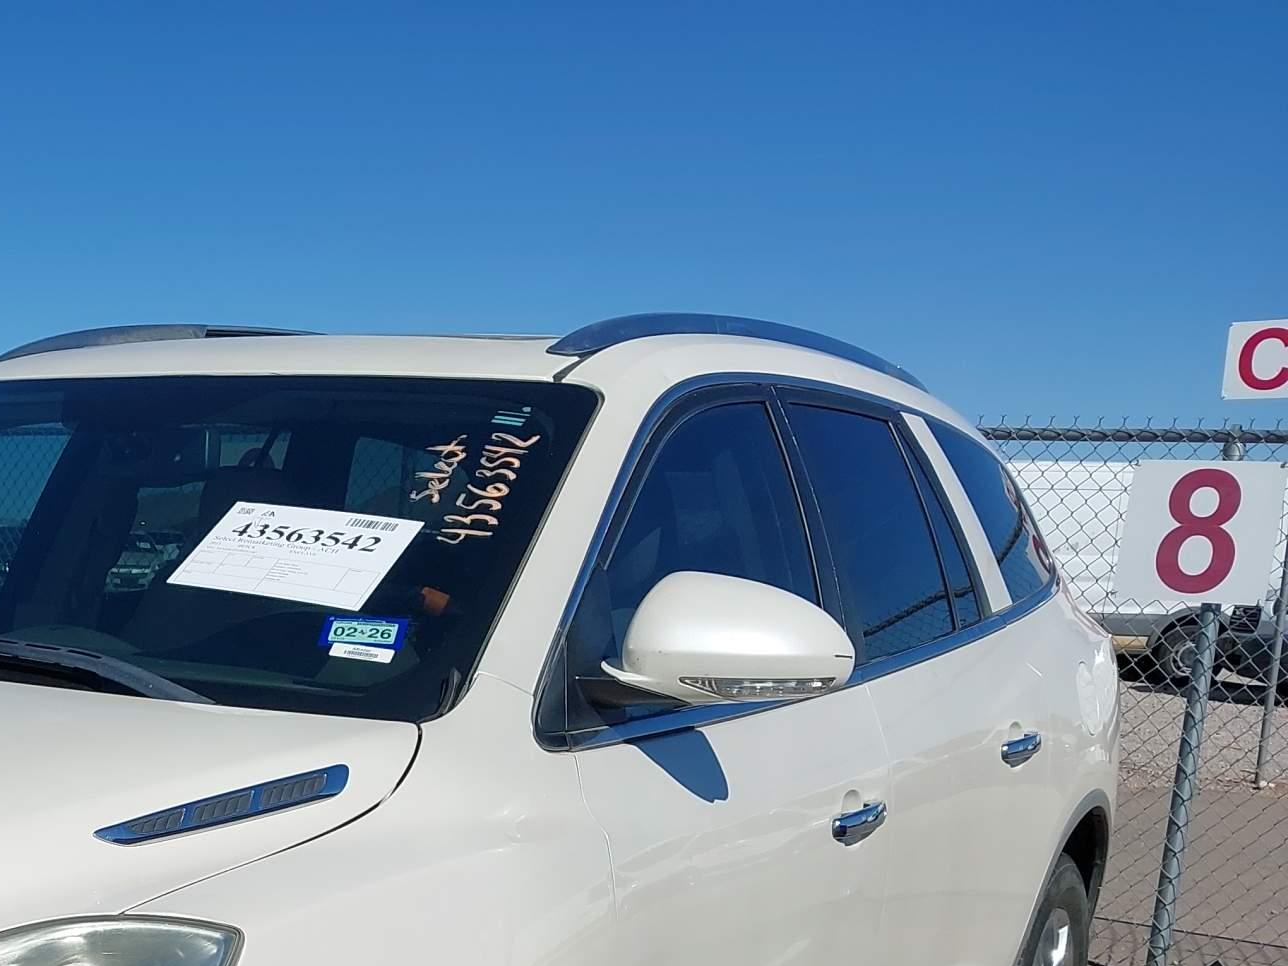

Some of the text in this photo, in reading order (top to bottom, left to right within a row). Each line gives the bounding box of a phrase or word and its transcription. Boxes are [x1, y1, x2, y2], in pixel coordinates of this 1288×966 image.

[410, 435, 468, 503] Select
[437, 432, 541, 544] 43563542
[231, 521, 383, 553] 43563542
[1155, 468, 1242, 594] 8
[367, 628, 393, 640] 26
